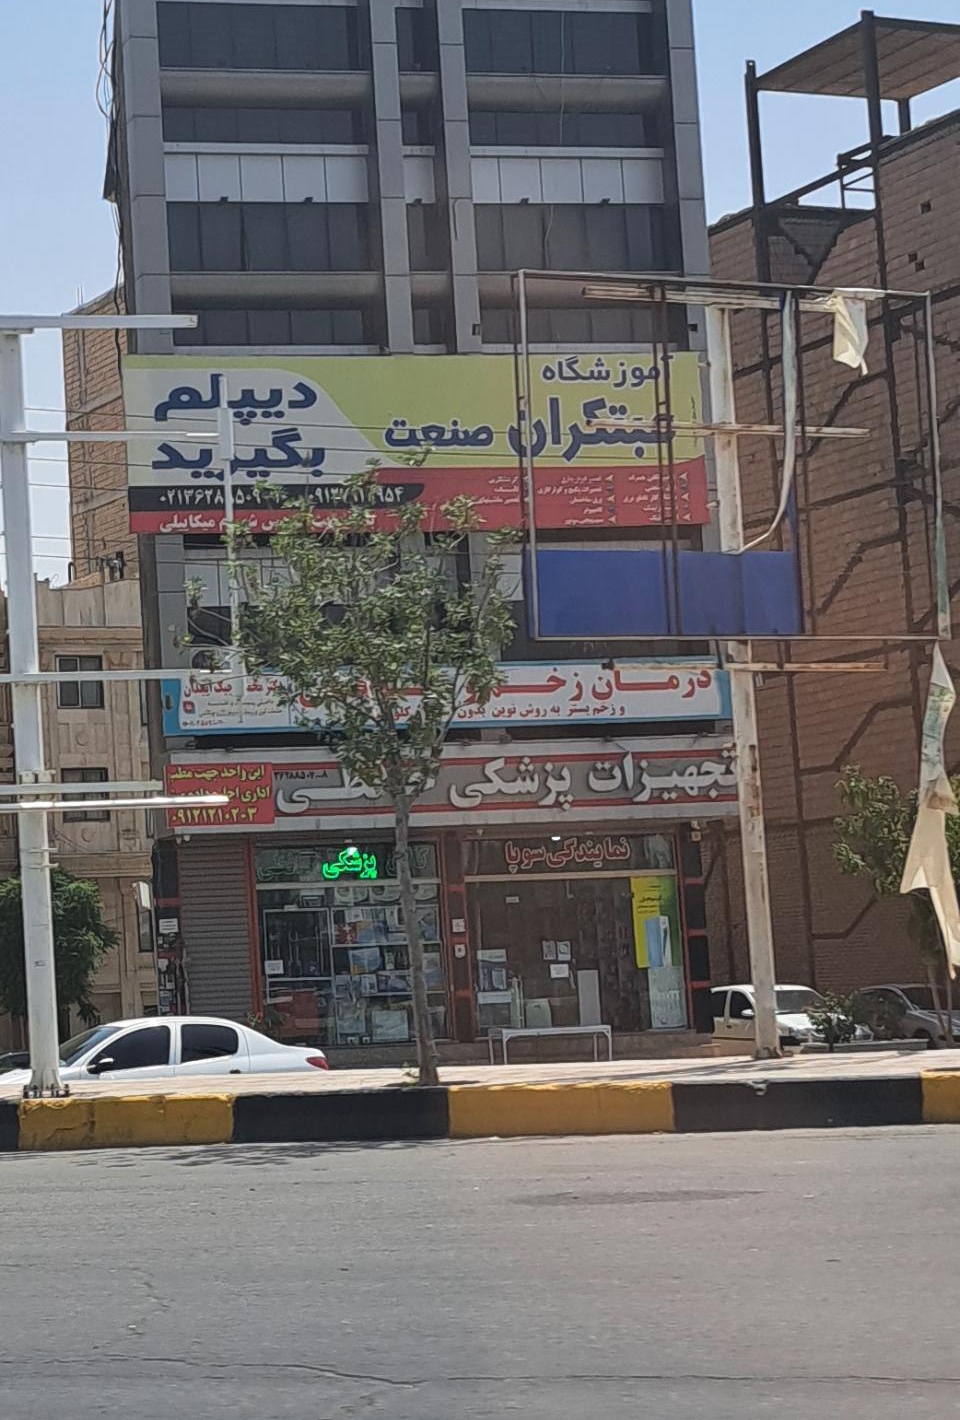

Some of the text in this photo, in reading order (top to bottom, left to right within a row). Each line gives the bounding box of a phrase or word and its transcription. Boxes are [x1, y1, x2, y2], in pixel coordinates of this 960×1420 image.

[154, 373, 317, 426] دیپلم
[384, 418, 495, 448] صنعت
[151, 427, 326, 481] بگیرید
[487, 667, 583, 702] زخم
[591, 669, 712, 701] درمان
[519, 703, 547, 718] روش
[448, 756, 575, 811] پزشکی
[588, 748, 738, 803] تجهیزات
[546, 835, 631, 868] نمایندگی
